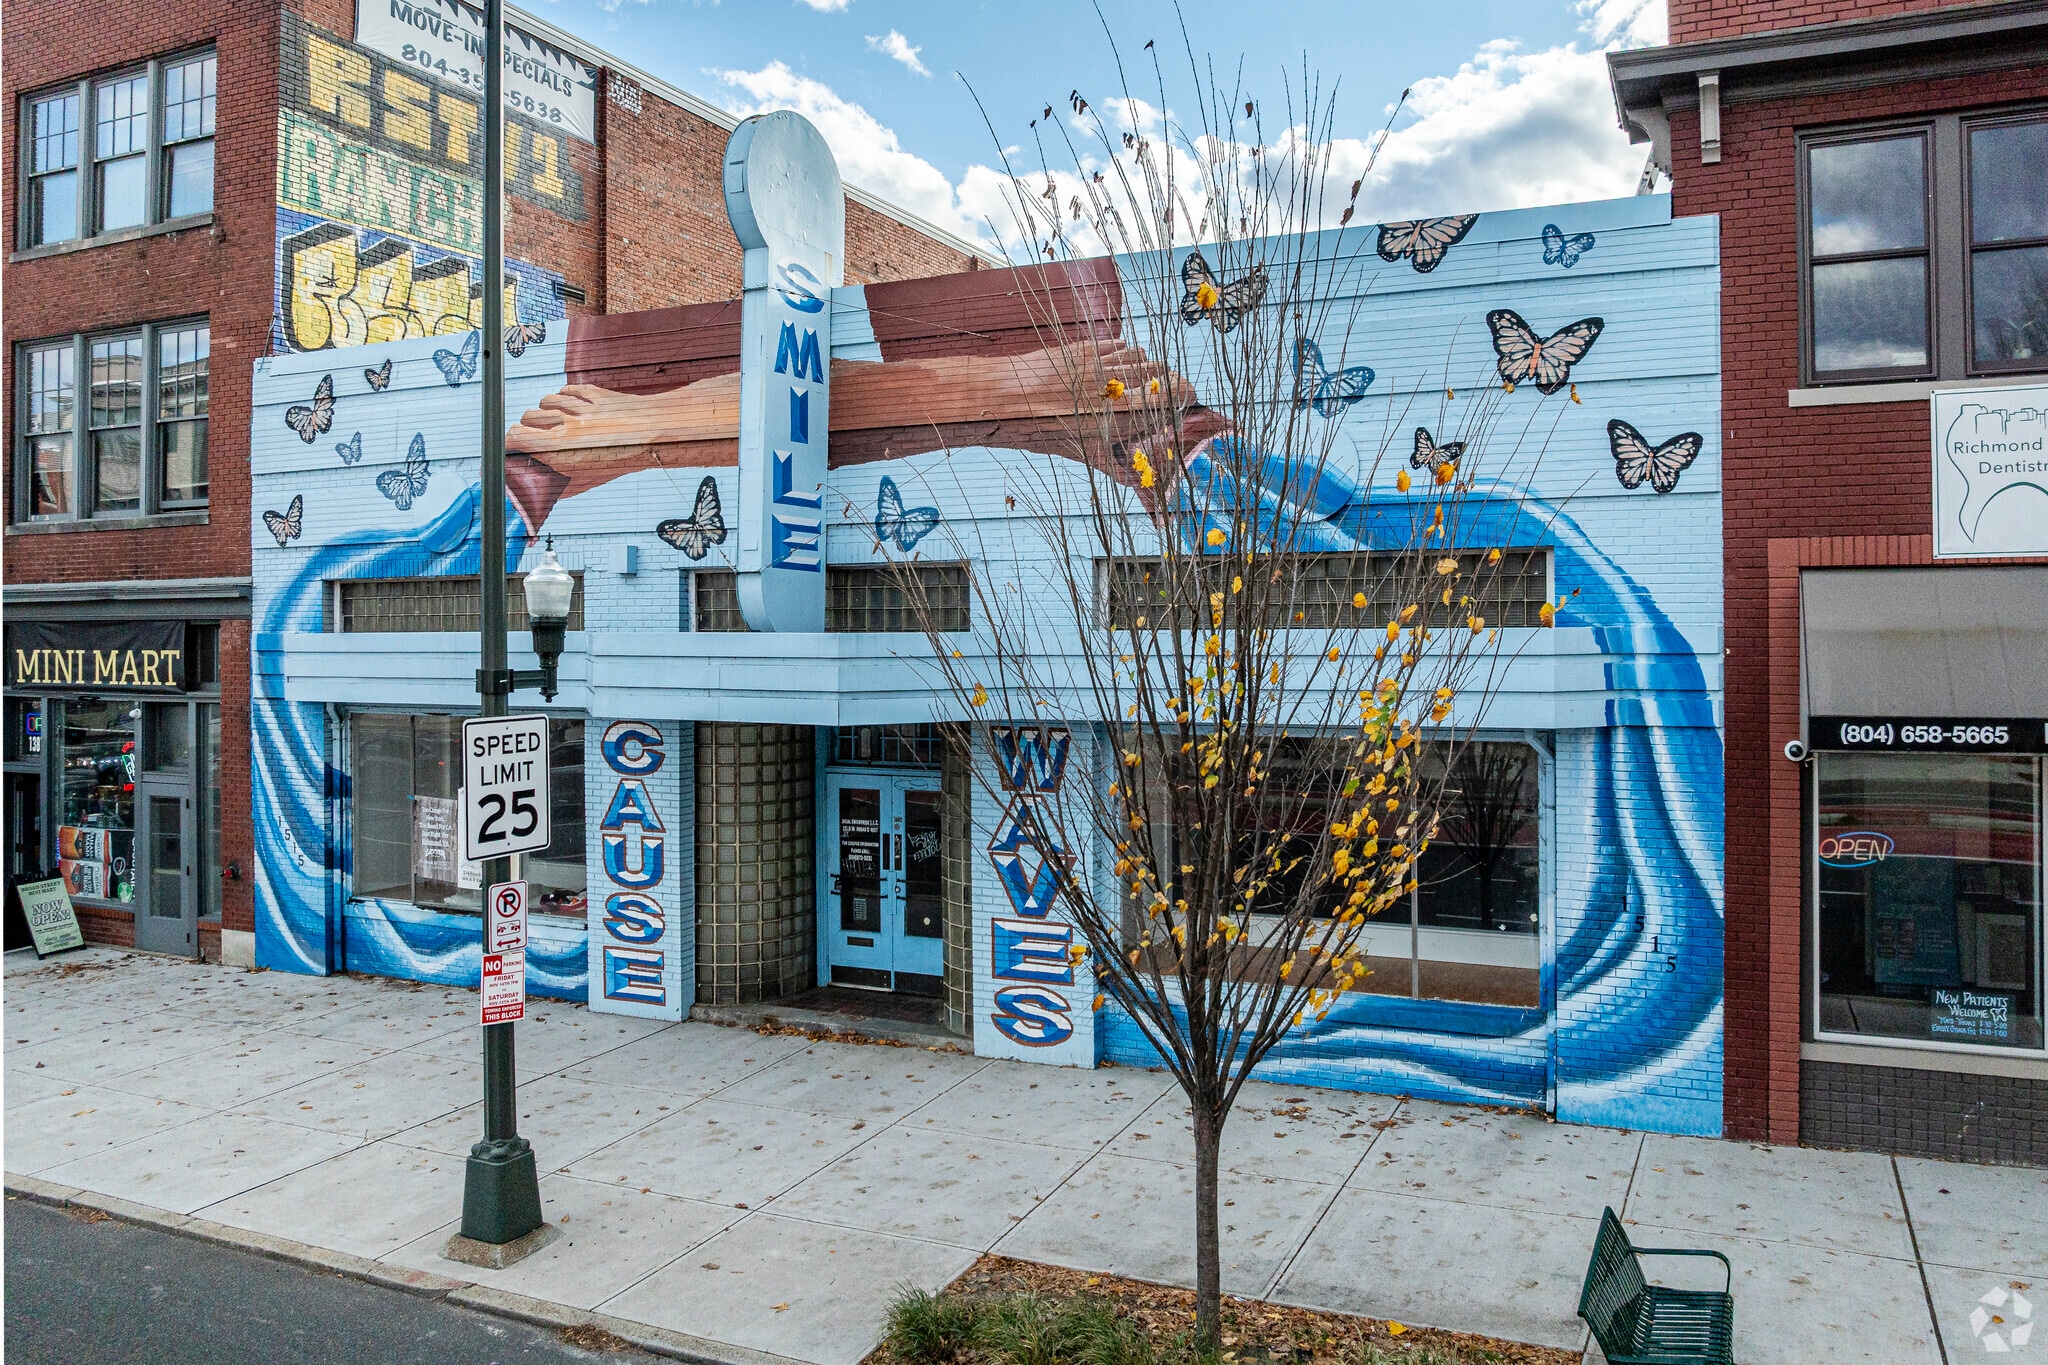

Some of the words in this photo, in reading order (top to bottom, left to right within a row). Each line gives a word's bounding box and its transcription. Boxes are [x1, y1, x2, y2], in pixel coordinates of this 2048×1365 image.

[390, 0, 483, 57] MOVE-IN
[502, 48, 573, 98] PECIALS
[401, 43, 562, 124] 804-35-5638
[772, 256, 825, 574] SMILE
[1954, 437, 2043, 454] Richmond
[16, 649, 86, 685] MINI
[92, 649, 180, 686] MART
[473, 731, 541, 758] SPEED
[1840, 722, 1894, 745] (804)
[1901, 725, 2009, 744] 658-5665
[480, 761, 534, 787] LIMIT
[477, 788, 539, 844] 25
[278, 815, 304, 867] 1515
[1819, 838, 1888, 861] OPEN
[599, 719, 667, 1007] CAUSE
[987, 725, 1078, 1048] WAVES
[32, 899, 63, 916] NOW
[32, 909, 71, 926] OPEN!
[1621, 895, 1677, 973] 1515
[485, 960, 501, 972] NO
[493, 974, 515, 982] FRIDAY
[488, 991, 520, 1001] SATURDAY
[502, 1009, 521, 1019] BLOCK
